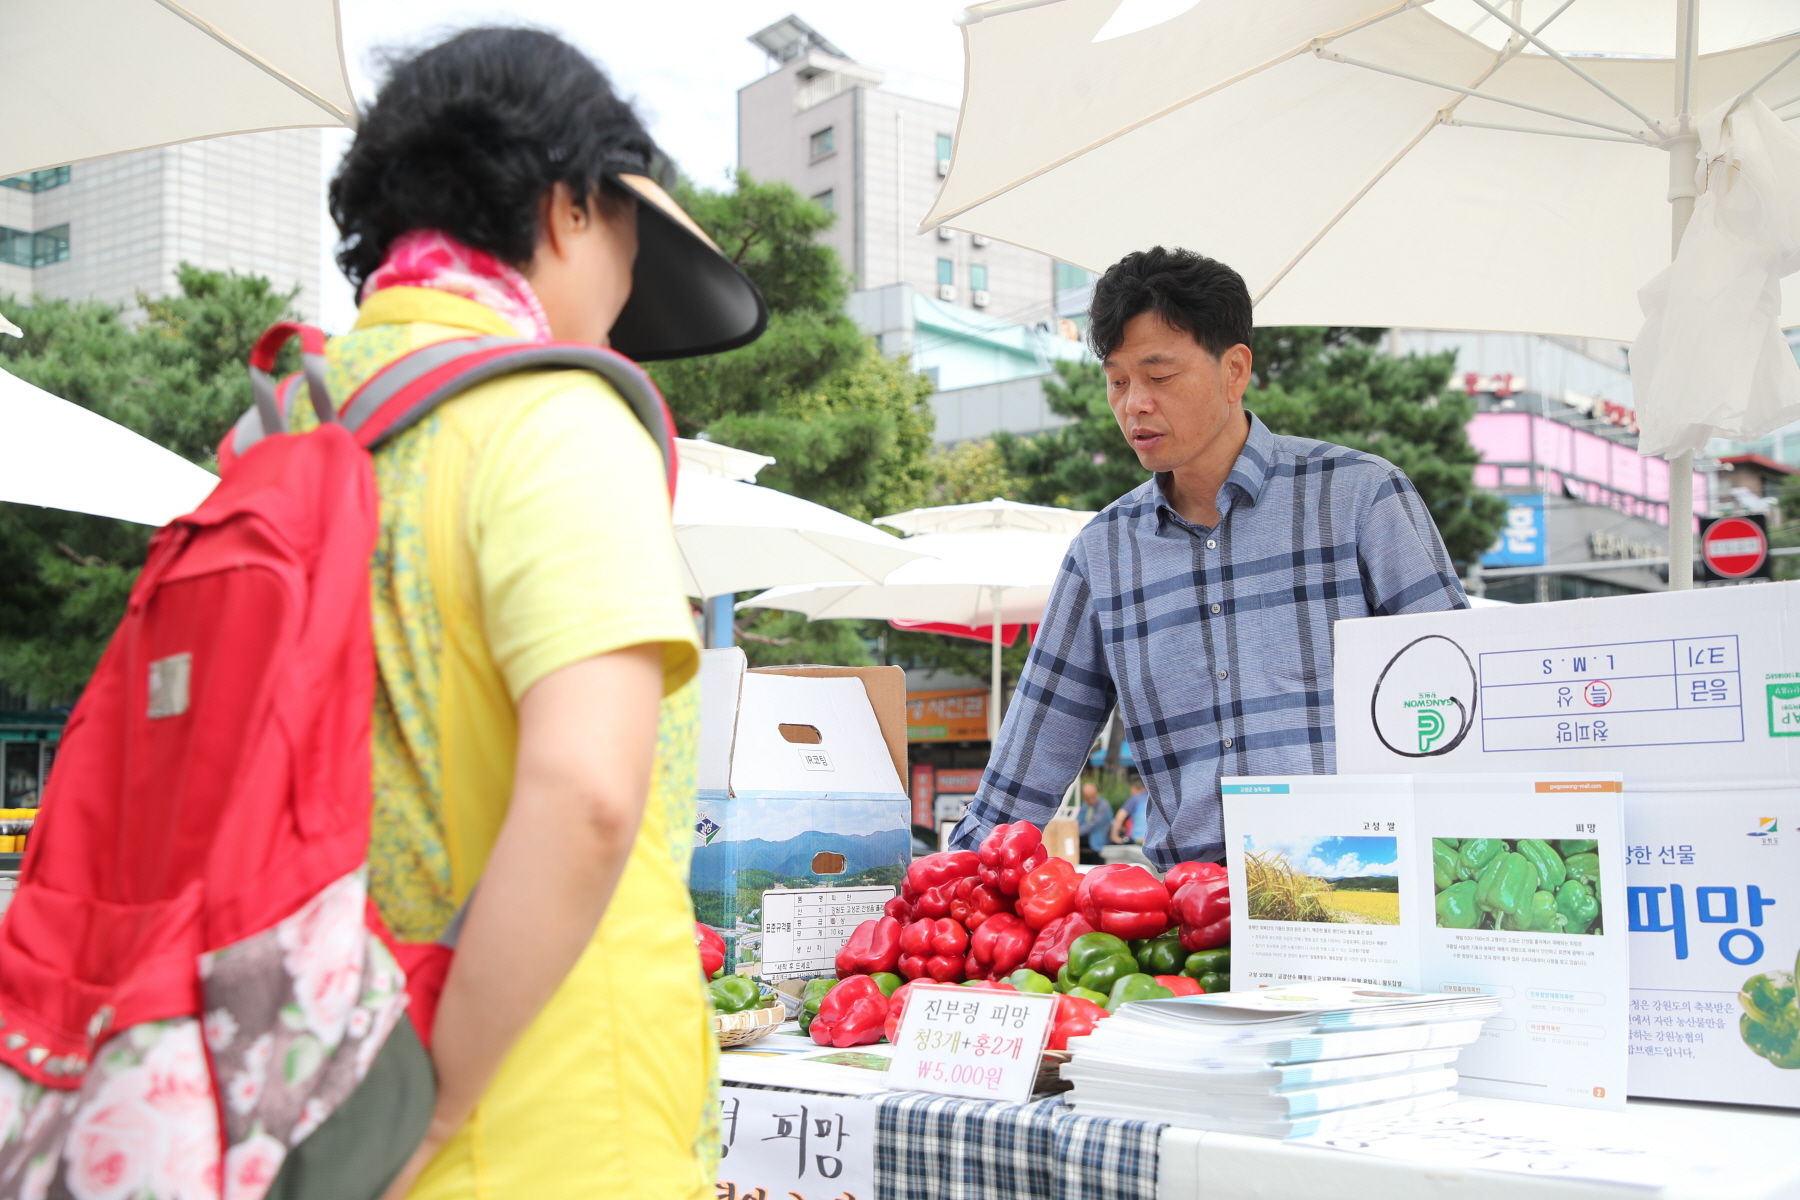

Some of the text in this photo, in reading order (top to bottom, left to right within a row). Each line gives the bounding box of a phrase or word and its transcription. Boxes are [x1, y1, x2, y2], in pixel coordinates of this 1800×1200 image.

[1688, 646, 1725, 668] 크기
[1557, 686, 1573, 708] 상
[1690, 678, 1728, 702] 등급
[1556, 720, 1609, 743] 청피망
[1363, 821, 1396, 832] 고성 쌀
[1657, 845, 1697, 866] 선물
[924, 999, 1031, 1029] 진부령 피망
[1629, 999, 1735, 1014] 청은 강원도의 축복받은
[1653, 1015, 1673, 1027] 자란
[1676, 1016, 1726, 1030] 농산물만을
[913, 1028, 1024, 1061] 청3개+홍2개
[1655, 1030, 1704, 1044] 강원농협의
[761, 1104, 851, 1180] 피망
